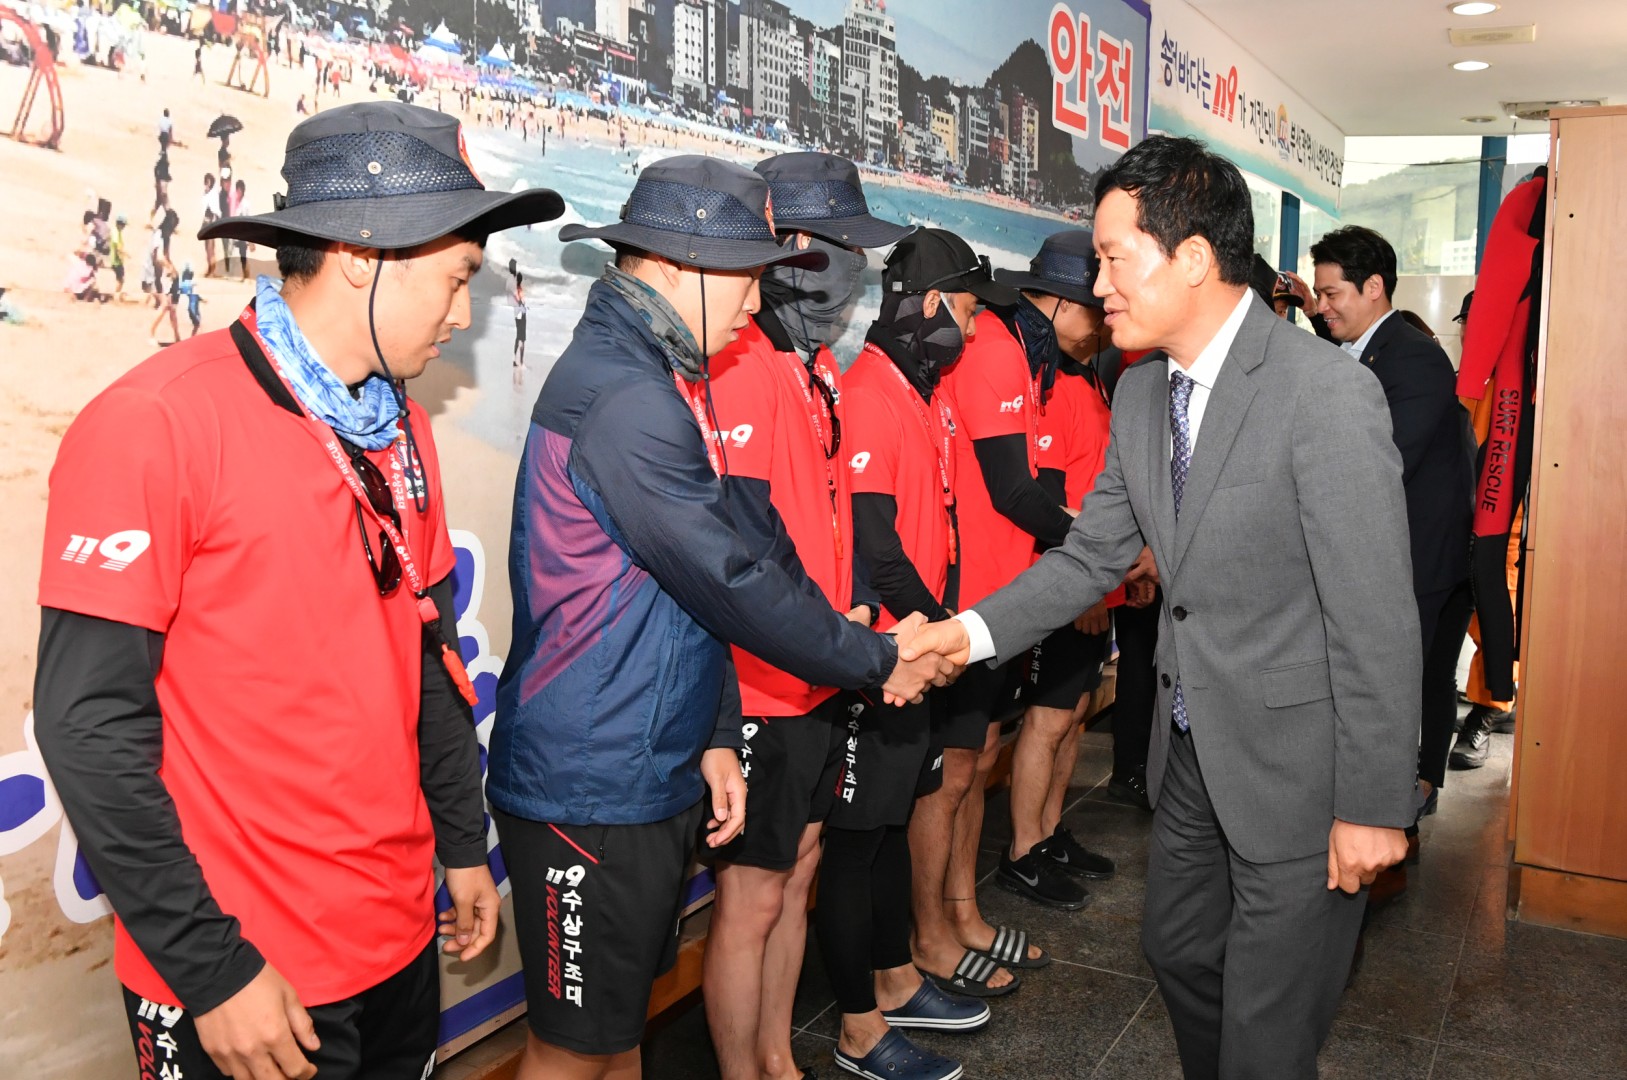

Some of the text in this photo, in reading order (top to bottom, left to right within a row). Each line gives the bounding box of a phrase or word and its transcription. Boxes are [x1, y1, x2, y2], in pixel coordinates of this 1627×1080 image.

[1050, 5, 1132, 152] 안전
[326, 440, 363, 497] SURF RESCUE
[392, 472, 406, 510] 수상구조대
[1481, 388, 1519, 513] SURF RESCUE
[60, 529, 151, 572] 119
[842, 720, 860, 804] 수상구조대
[545, 864, 586, 1008] 119 수상구조대
[545, 883, 562, 1000] VOLUNTEER
[137, 997, 184, 1029] 119
